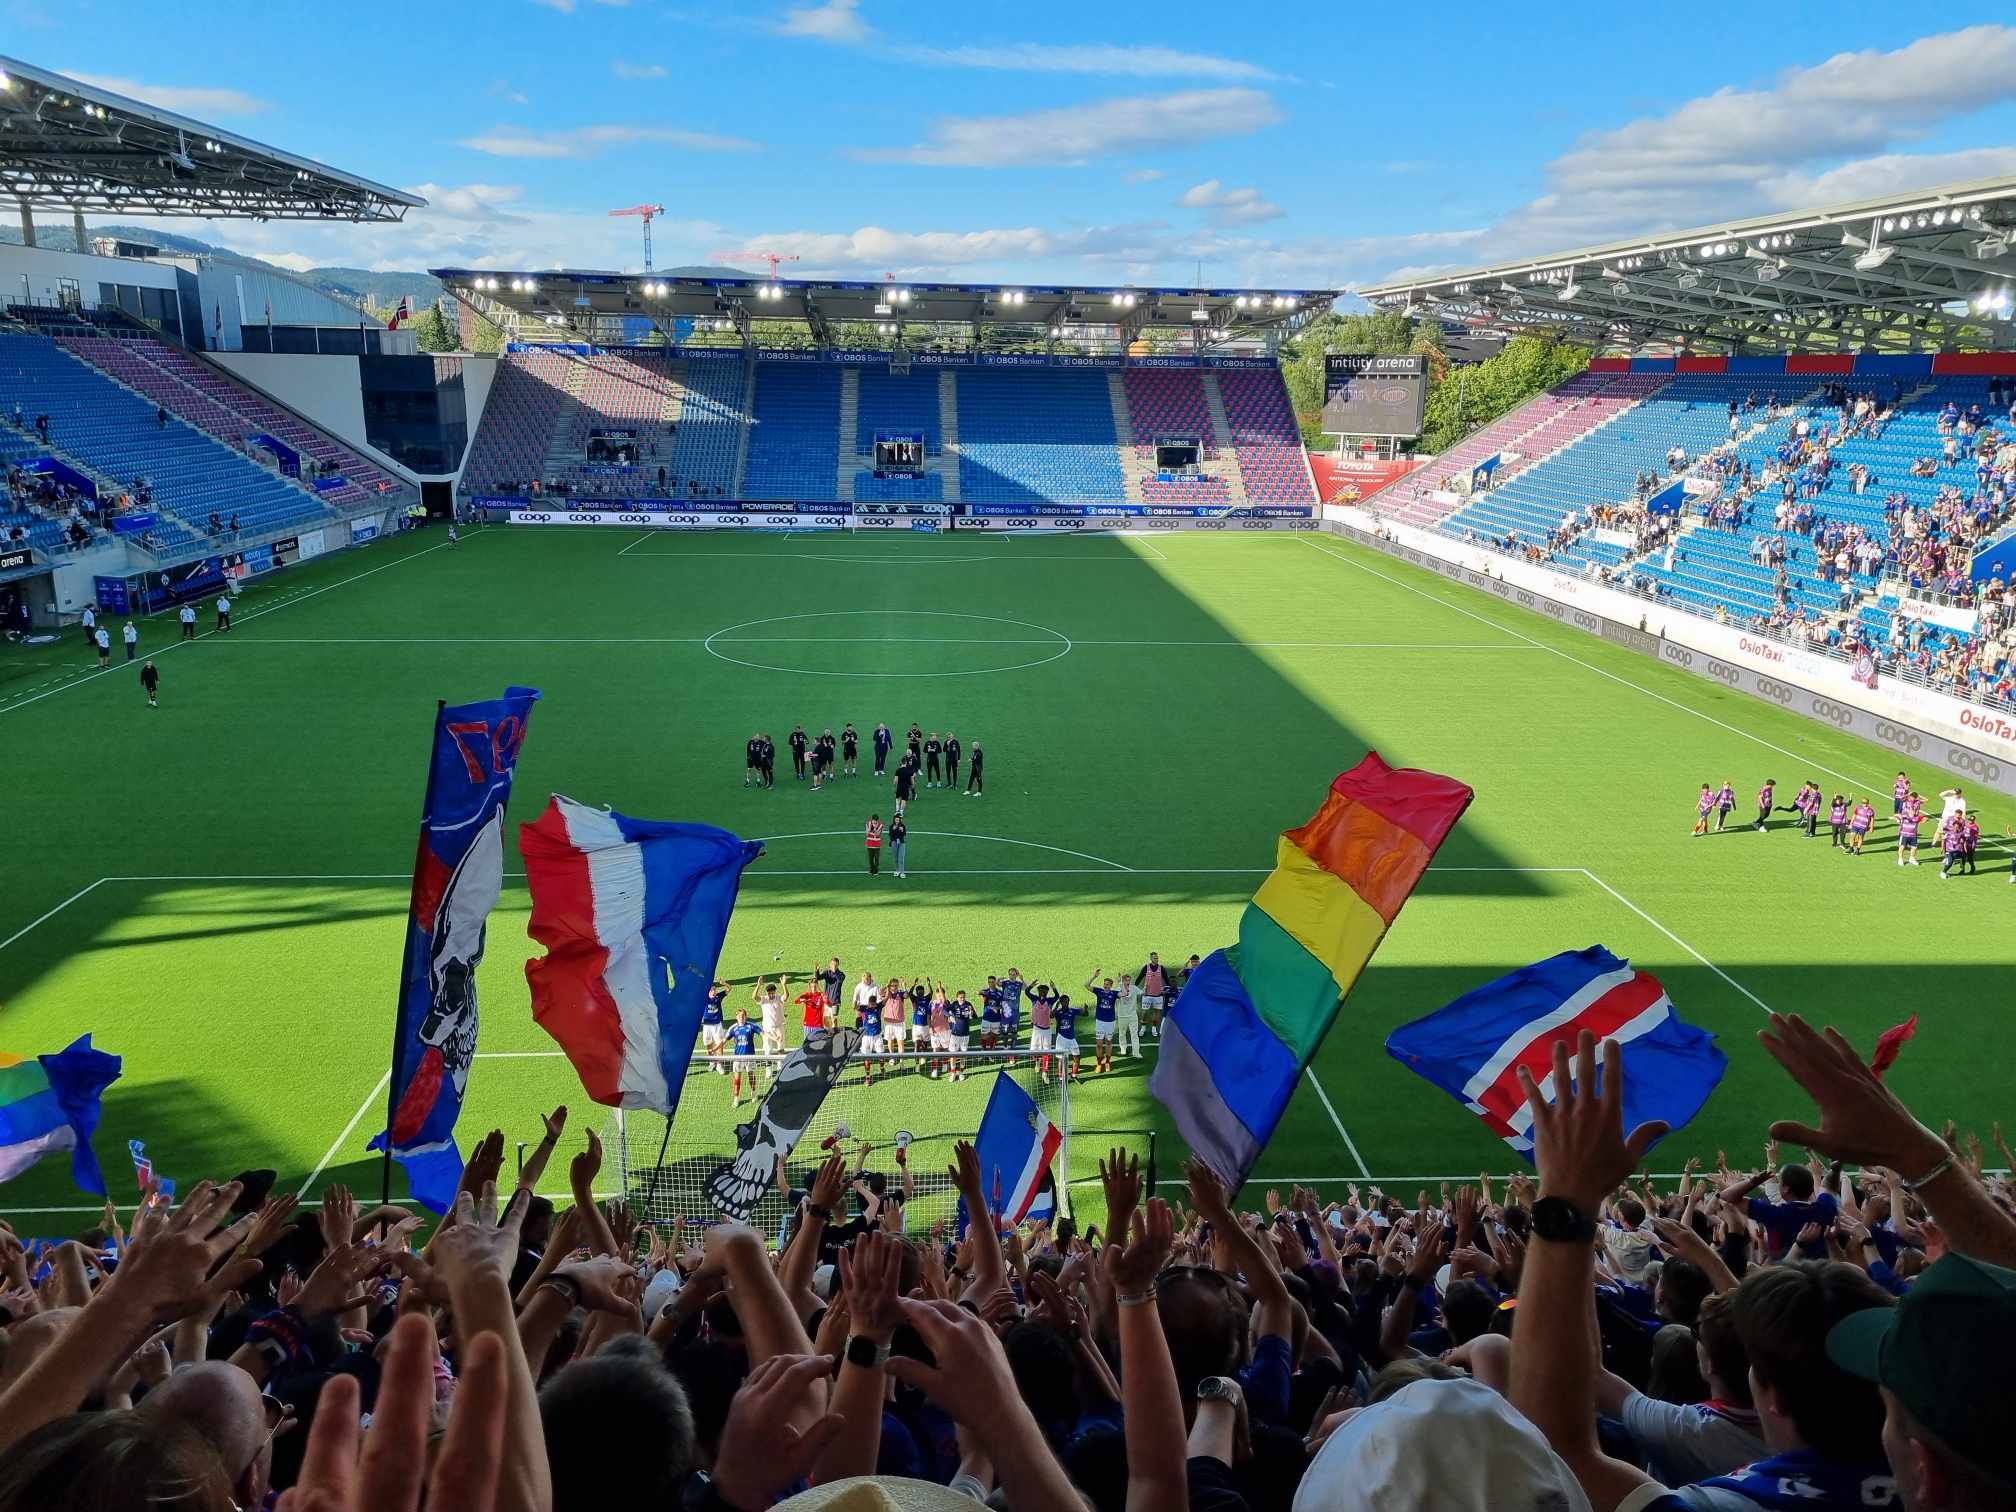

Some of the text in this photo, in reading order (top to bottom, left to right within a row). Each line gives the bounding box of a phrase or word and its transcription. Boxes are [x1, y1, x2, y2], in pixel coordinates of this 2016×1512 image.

[1331, 357, 1414, 371] intility arena
[1337, 462, 1374, 470] TOYOTA
[519, 514, 551, 522] coop
[570, 514, 601, 522] coop
[620, 515, 650, 524] coop
[669, 516, 700, 524] coop
[718, 516, 749, 525] coop
[767, 516, 798, 525] coop
[815, 516, 845, 525] coop
[863, 518, 894, 527] coop
[911, 518, 941, 527] coop
[959, 519, 990, 527] coop
[1007, 519, 1037, 528] coop
[1055, 519, 1084, 528] coop
[1101, 519, 1132, 528] coop
[1150, 520, 1179, 529] coop
[1196, 520, 1226, 529] coop
[1242, 521, 1272, 530] coop
[1289, 521, 1319, 530] coop
[2, 556, 23, 568] arena
[1427, 556, 1440, 570] coop
[1447, 564, 1461, 578] coop
[1468, 571, 1485, 587] coop
[1493, 581, 1509, 598] coop
[1517, 591, 1535, 608] coop
[1544, 602, 1564, 619] coop
[1574, 612, 1597, 630] coop
[1739, 638, 1782, 662] OsloTaxi
[1665, 644, 1692, 667] coop
[1708, 660, 1740, 684] coop
[1757, 678, 1792, 704] coop
[1812, 699, 1852, 727] coop
[1875, 721, 1922, 753] coop
[1948, 749, 2000, 783] coop
